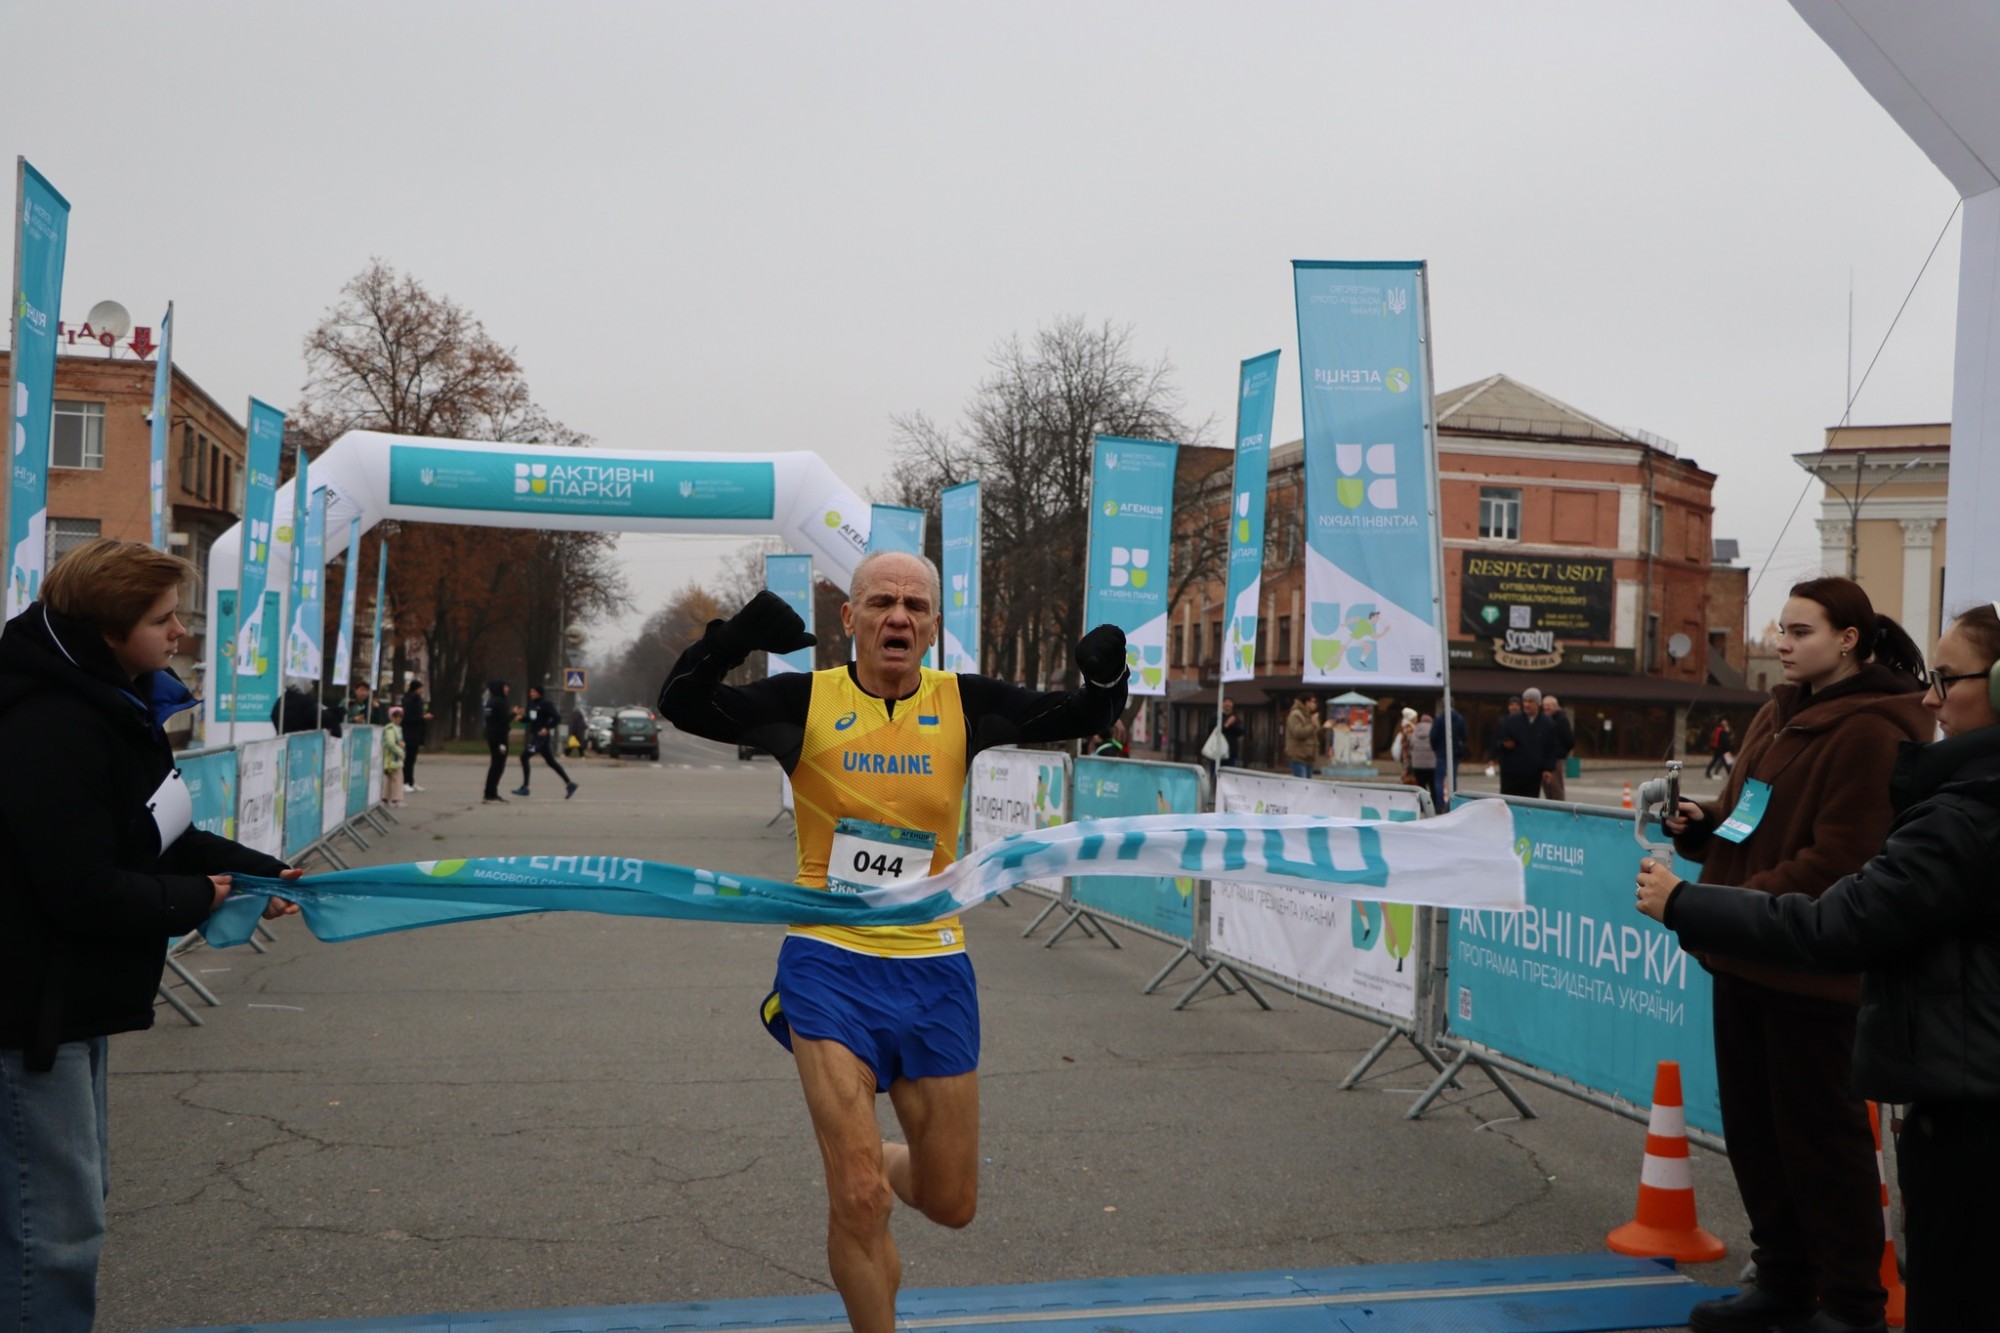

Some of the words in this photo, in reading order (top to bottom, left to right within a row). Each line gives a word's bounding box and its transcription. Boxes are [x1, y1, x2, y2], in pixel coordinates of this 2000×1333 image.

[551, 464, 654, 483] АКТИВНІ
[549, 480, 631, 498] ПАРКИ
[1119, 503, 1163, 516] АГЕНЦІЯ
[841, 524, 869, 549] АГЕН
[1468, 559, 1553, 579] RESPECT
[1557, 564, 1607, 582] USDT
[843, 751, 933, 775] UKRAINE
[853, 850, 904, 878] 044
[1532, 842, 1584, 866] АГЕНЦІЯ
[474, 868, 538, 886] МАСОВОГО
[1459, 904, 1571, 959] АКТИВНІ
[1579, 916, 1687, 990] ПАРКИ
[1458, 941, 1519, 979] ПРОГРАМА
[1522, 960, 1615, 1006] ПРЕЗИДЕНТА
[1618, 986, 1684, 1027] УКРАЇНИ
